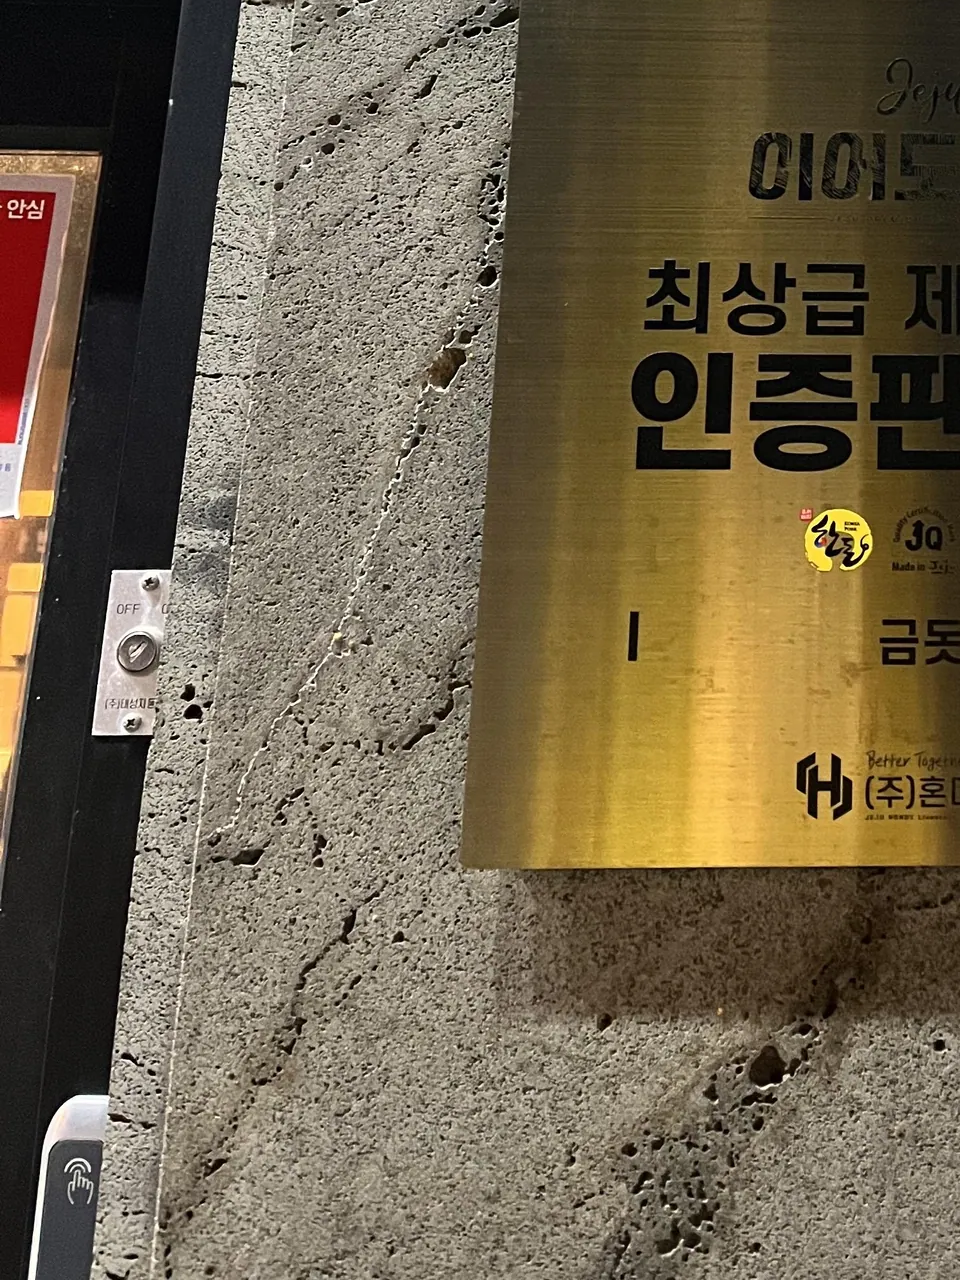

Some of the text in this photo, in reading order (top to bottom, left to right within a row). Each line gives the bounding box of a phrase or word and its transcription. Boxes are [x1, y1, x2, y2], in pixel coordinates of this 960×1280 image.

[7, 199, 45, 220] 안심
[643, 259, 870, 336] 최상급
[892, 561, 915, 571] Made
[116, 603, 141, 614] OFF
[865, 750, 911, 768] Better
